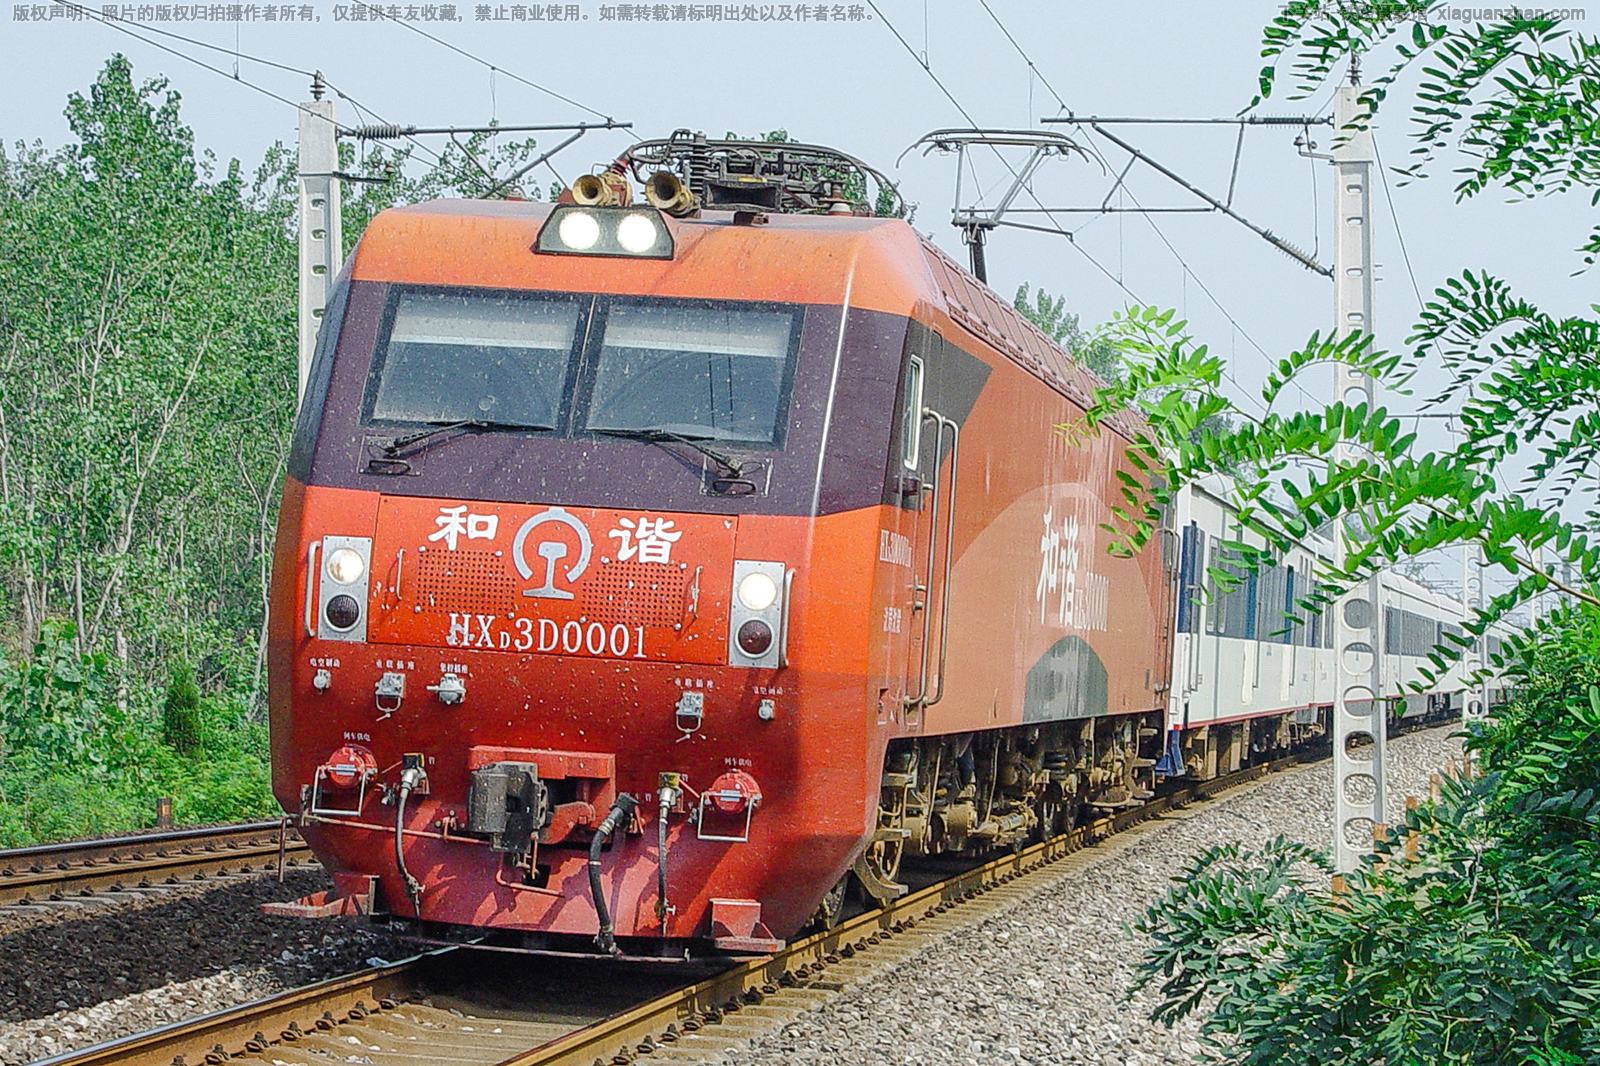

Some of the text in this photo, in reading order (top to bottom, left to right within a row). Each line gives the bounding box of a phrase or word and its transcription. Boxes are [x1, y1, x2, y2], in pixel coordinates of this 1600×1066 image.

[428, 505, 682, 564] 和 谐
[1036, 505, 1079, 627] 和谐
[446, 612, 647, 658] HXD3D0001
